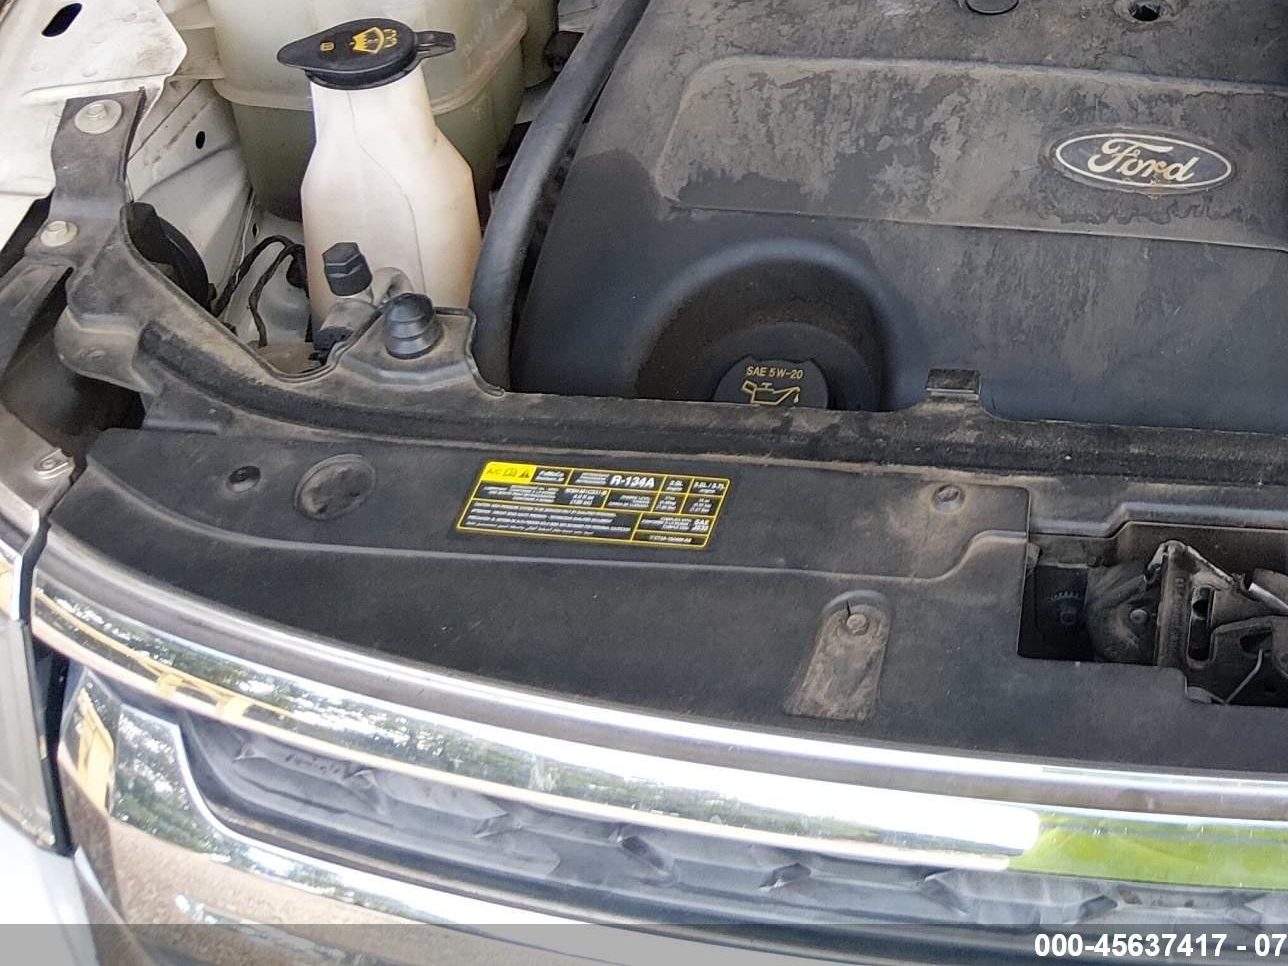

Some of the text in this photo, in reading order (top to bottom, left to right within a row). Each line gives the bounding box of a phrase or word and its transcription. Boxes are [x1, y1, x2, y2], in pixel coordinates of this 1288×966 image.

[1088, 138, 1200, 182] Ford
[746, 365, 804, 380] SAE 5W-20
[610, 475, 655, 489] R-134A
